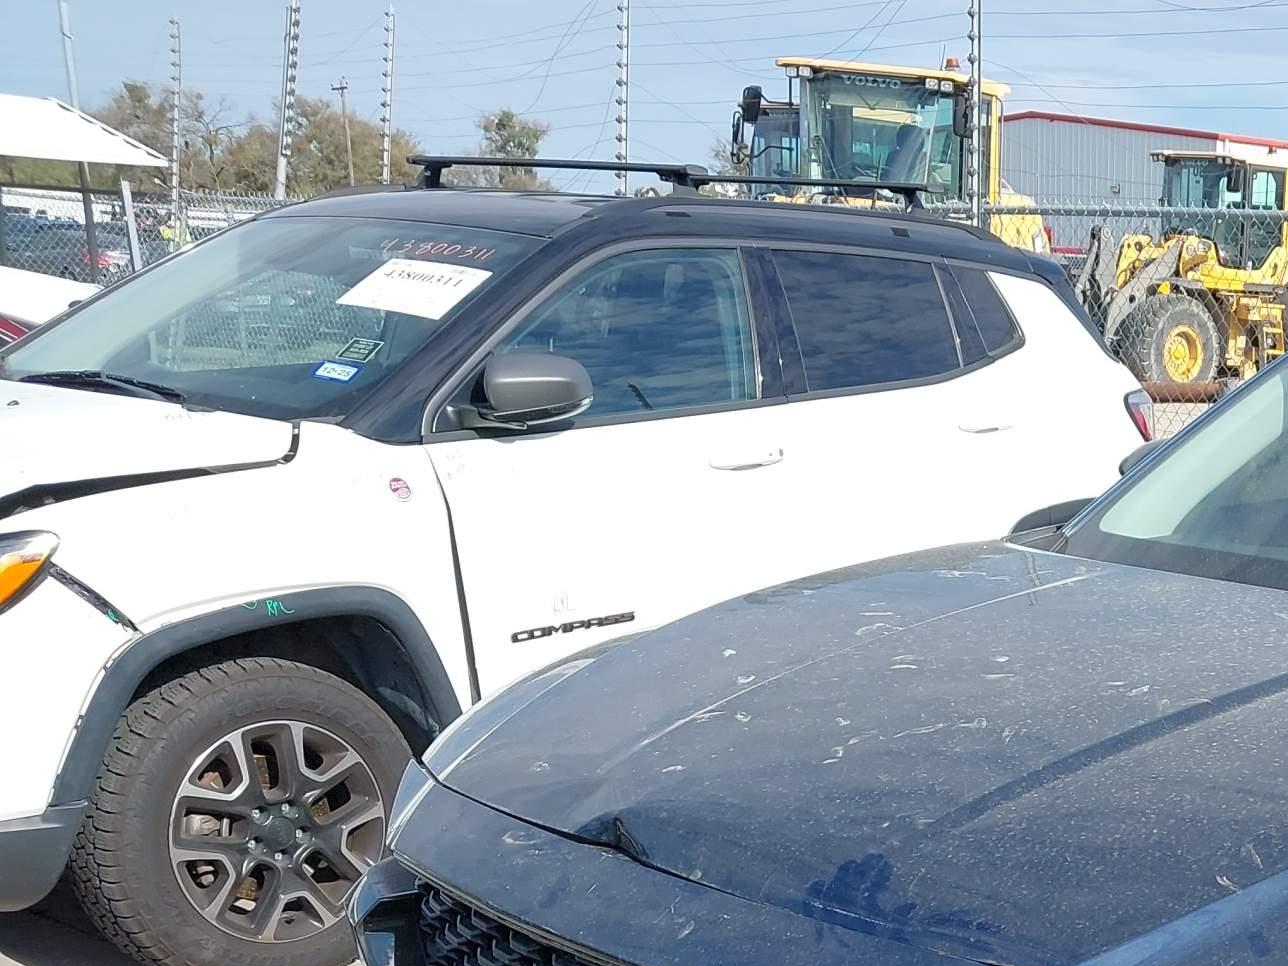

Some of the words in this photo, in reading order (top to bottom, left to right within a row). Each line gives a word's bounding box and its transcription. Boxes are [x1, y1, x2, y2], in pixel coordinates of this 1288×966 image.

[841, 75, 901, 88] VOLVO
[380, 238, 495, 260] 43800311
[384, 269, 463, 287] 43800311
[511, 611, 635, 643] COMPASS
